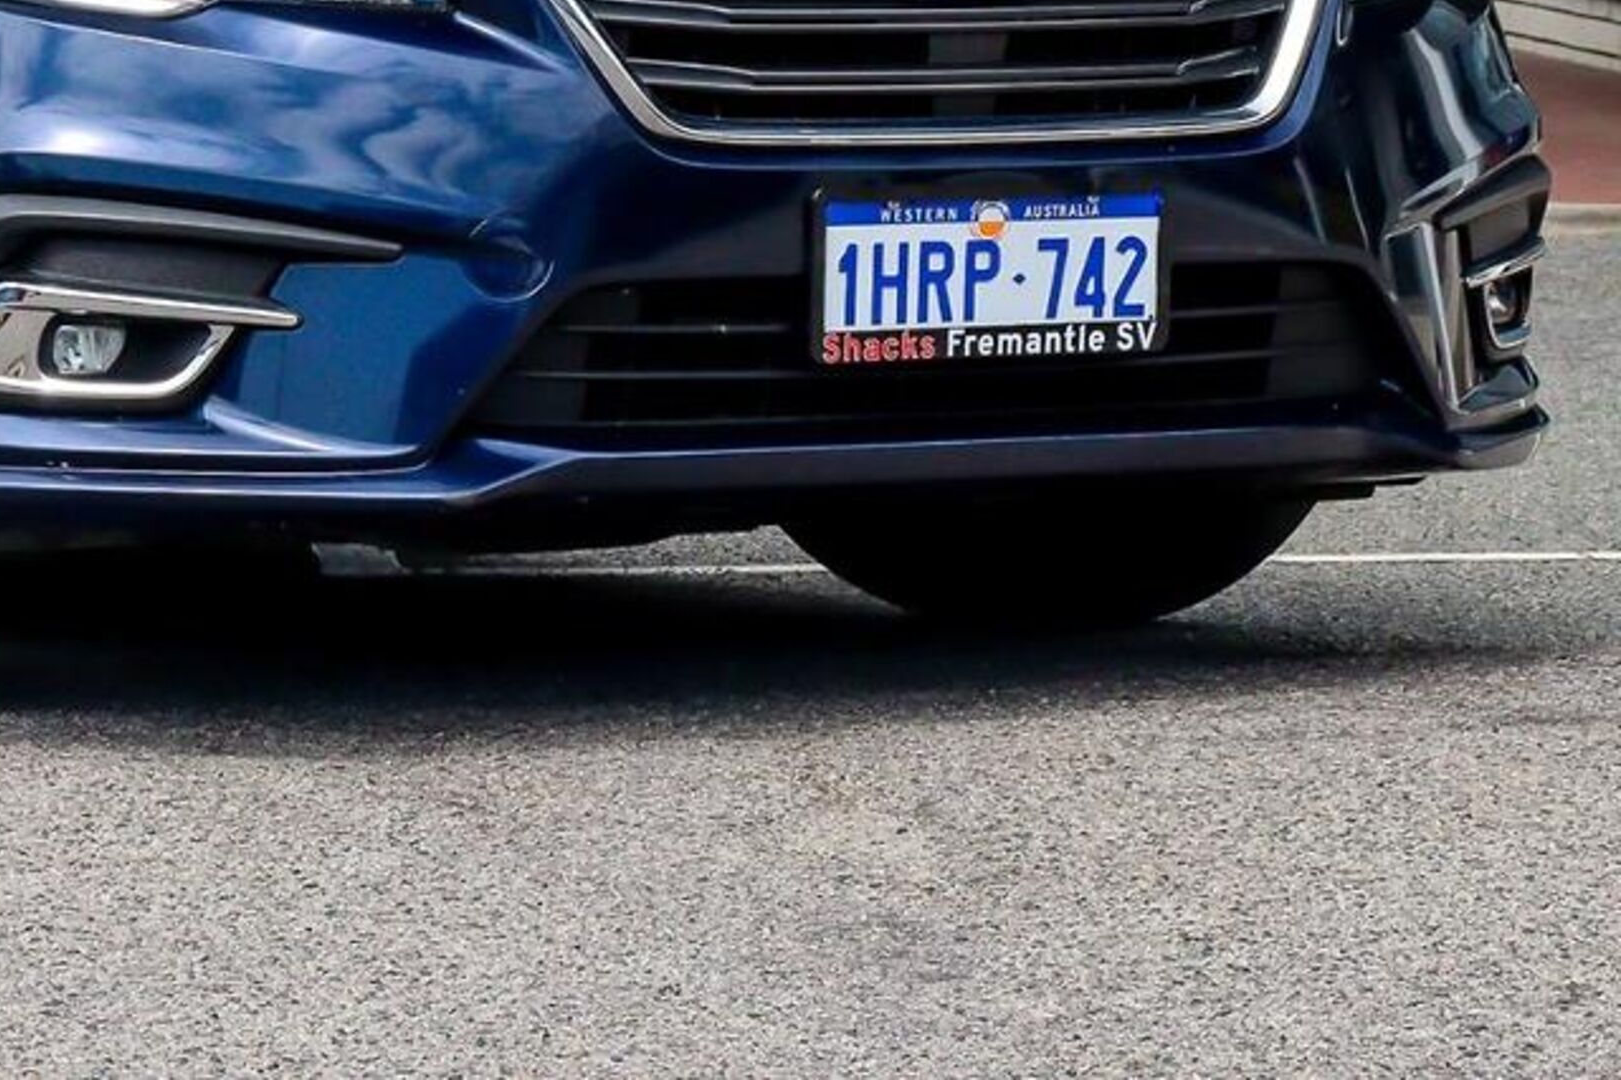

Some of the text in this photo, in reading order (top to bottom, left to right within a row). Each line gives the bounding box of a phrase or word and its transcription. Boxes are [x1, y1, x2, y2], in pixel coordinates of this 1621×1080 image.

[881, 203, 1100, 222] WESTERN AUSTRALIA
[823, 322, 1157, 364] Shacks Fremantle SV
